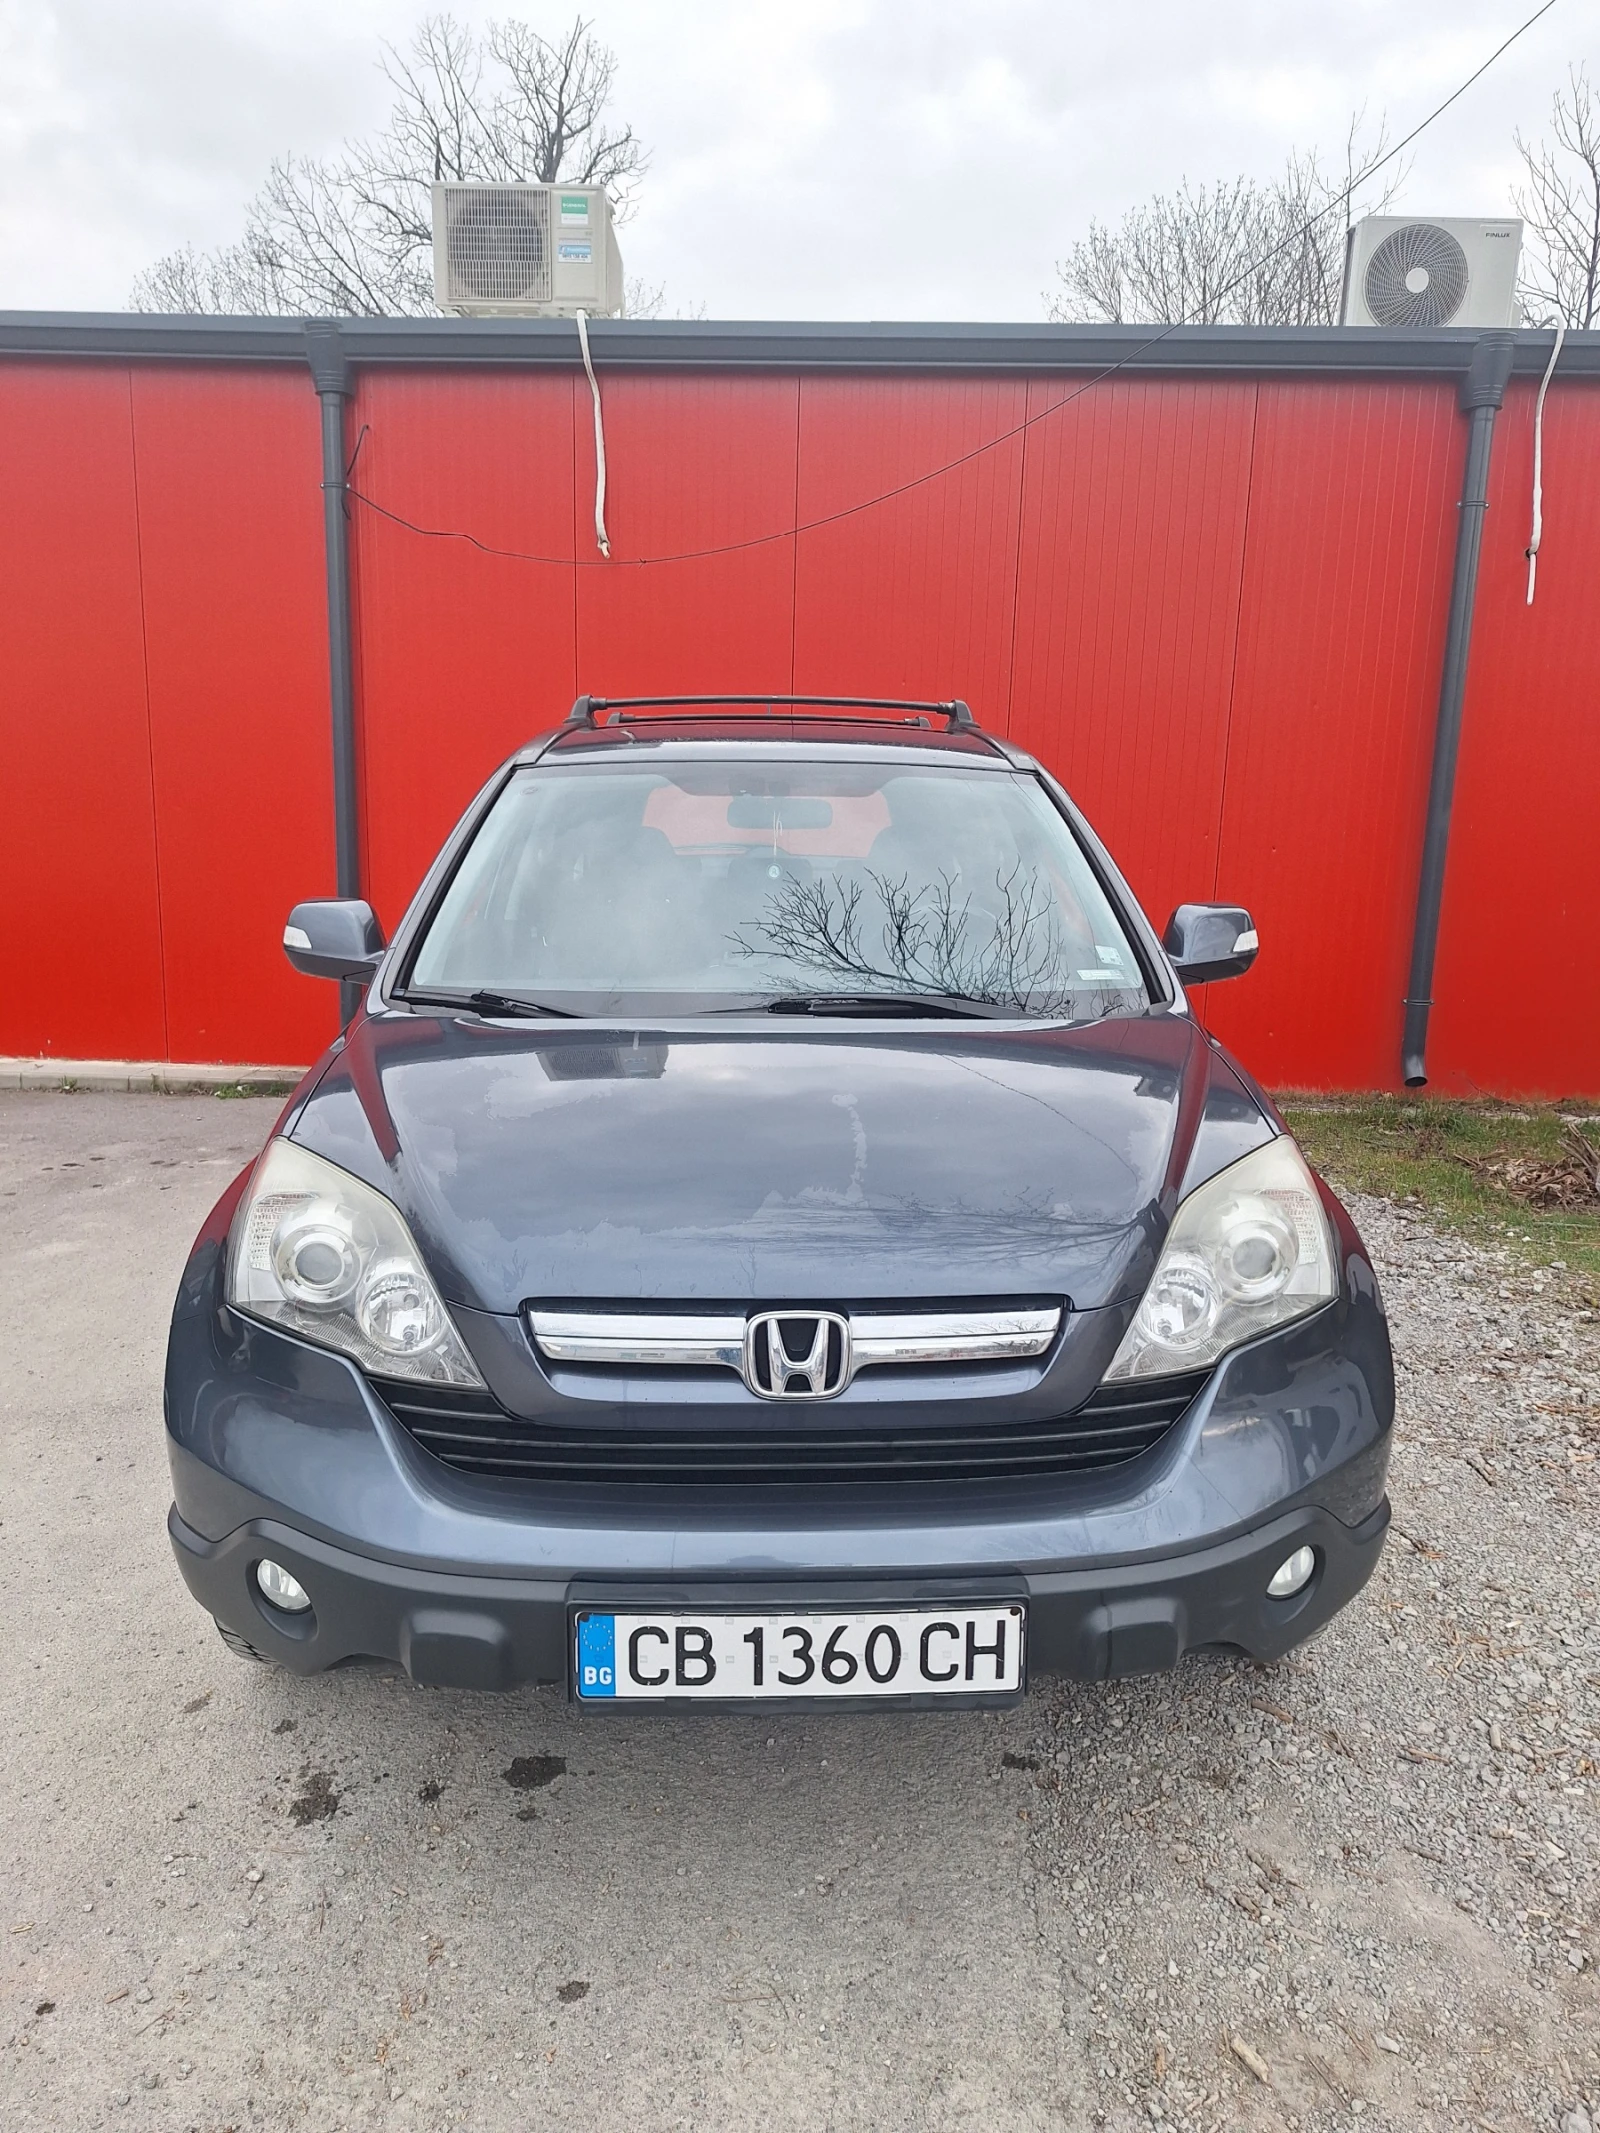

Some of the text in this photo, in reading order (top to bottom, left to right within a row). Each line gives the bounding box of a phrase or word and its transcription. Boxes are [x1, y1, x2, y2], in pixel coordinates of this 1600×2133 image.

[628, 1620, 1006, 1686] CB 1360 CH
[584, 1666, 612, 1685] BG
